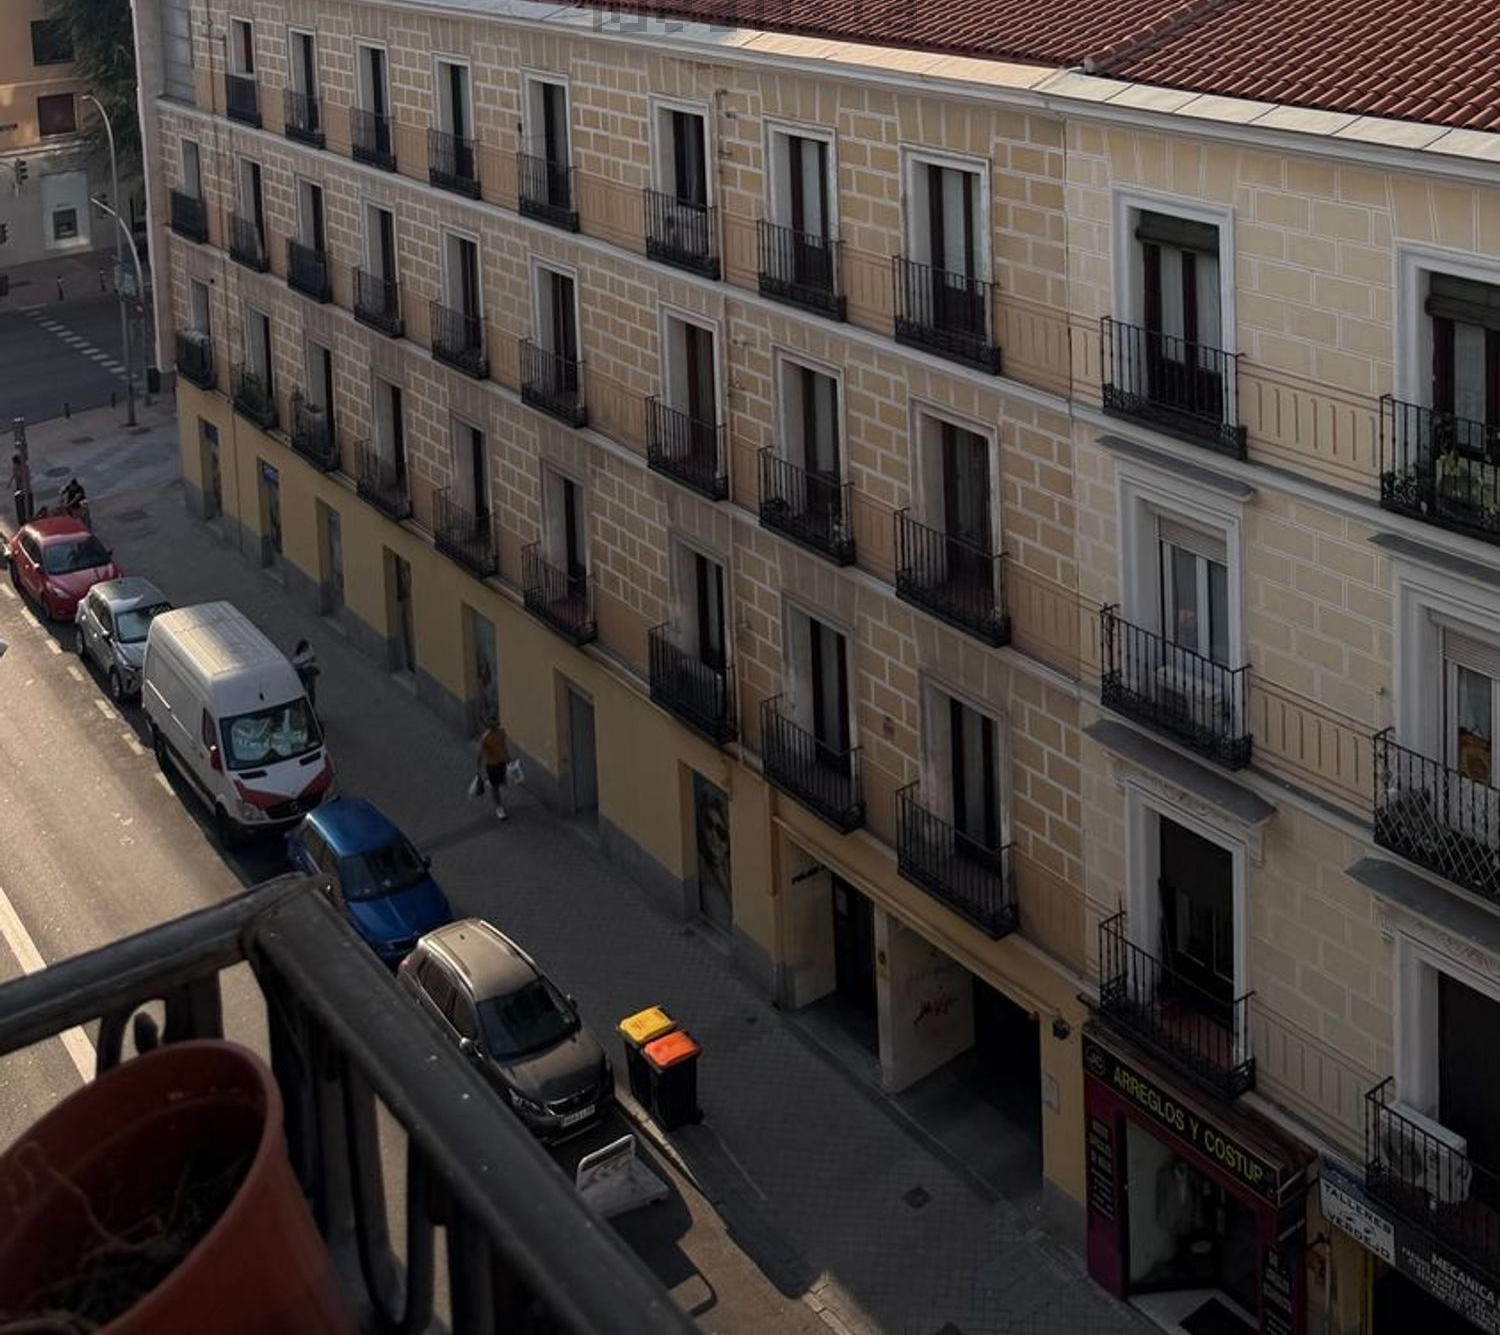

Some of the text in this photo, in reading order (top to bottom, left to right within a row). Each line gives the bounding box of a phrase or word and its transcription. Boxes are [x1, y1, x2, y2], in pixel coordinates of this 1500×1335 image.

[1113, 1065, 1267, 1187] ARREGLOS Y COSTUR
[1322, 1183, 1391, 1235] TALLERES
[1431, 1252, 1495, 1306] MECANICA
